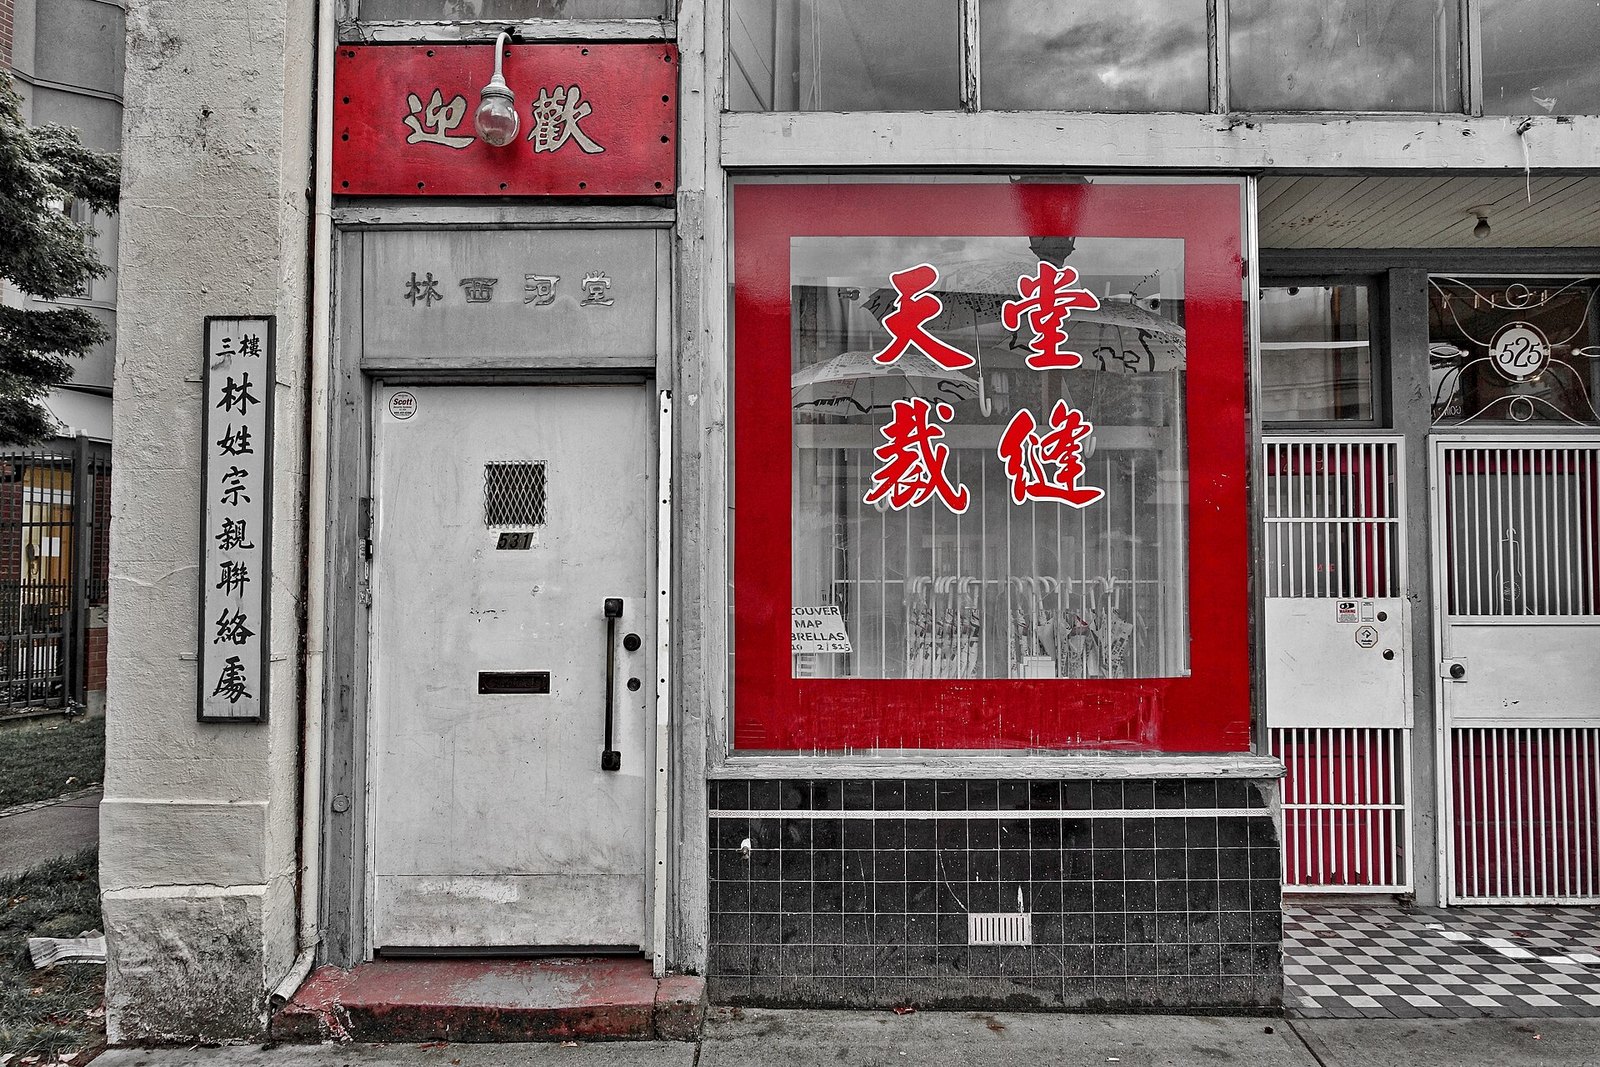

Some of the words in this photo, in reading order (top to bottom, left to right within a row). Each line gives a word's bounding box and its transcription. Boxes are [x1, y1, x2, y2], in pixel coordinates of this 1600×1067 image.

[404, 270, 615, 307] 林西河堂
[873, 260, 1101, 370] 天堂
[215, 333, 262, 358] 三樓
[1499, 337, 1542, 367] 525
[393, 398, 413, 406] Scott
[863, 397, 1105, 514] 裁縫
[498, 533, 530, 549] 531
[794, 619, 823, 629] MAP
